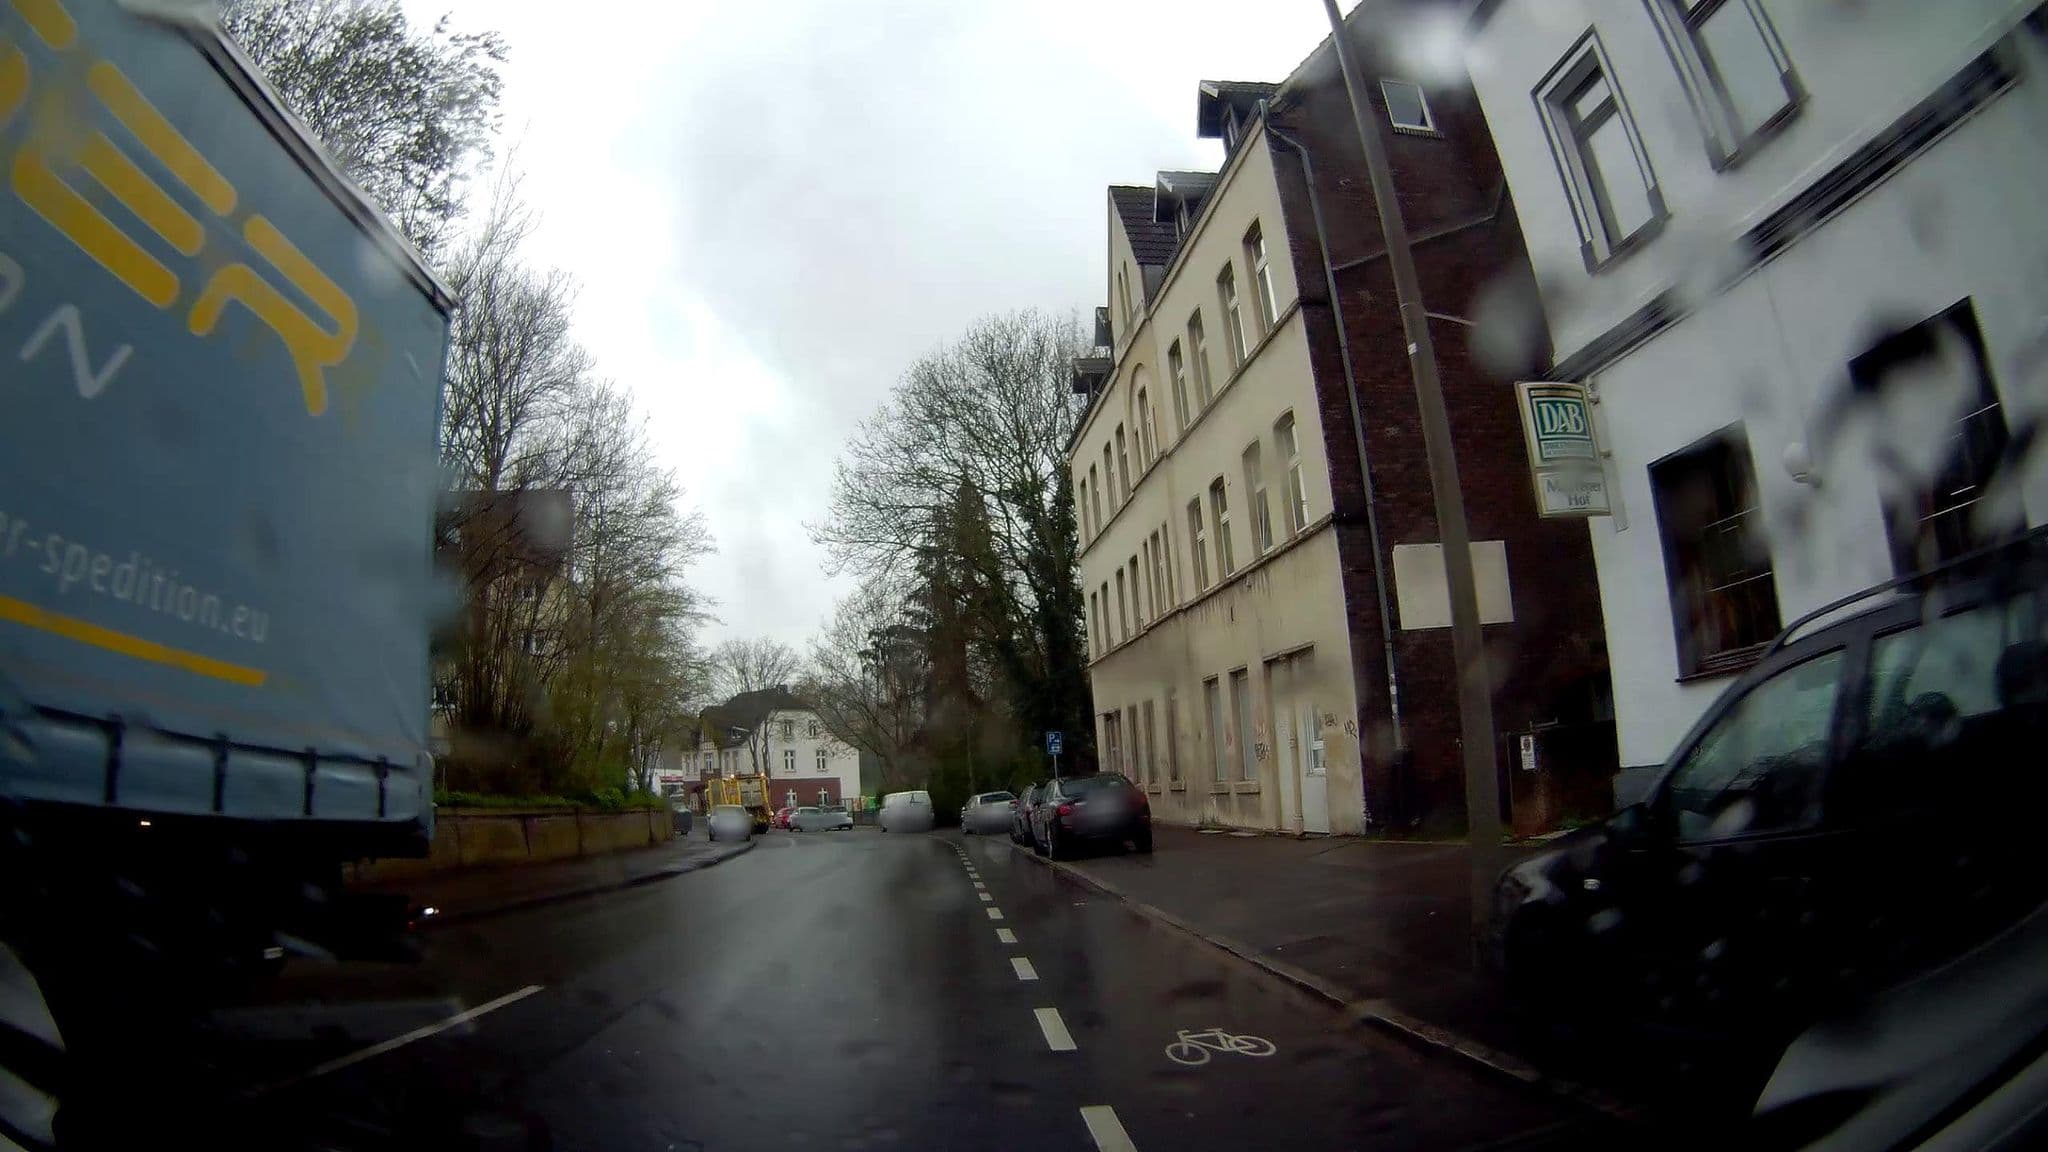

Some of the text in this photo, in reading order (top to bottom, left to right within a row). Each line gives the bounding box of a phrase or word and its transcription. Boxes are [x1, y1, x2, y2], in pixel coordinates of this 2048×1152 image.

[0, 0, 359, 416] ER
[1539, 403, 1584, 433] DAB
[1568, 493, 1591, 506] Hof
[1049, 734, 1056, 743] P
